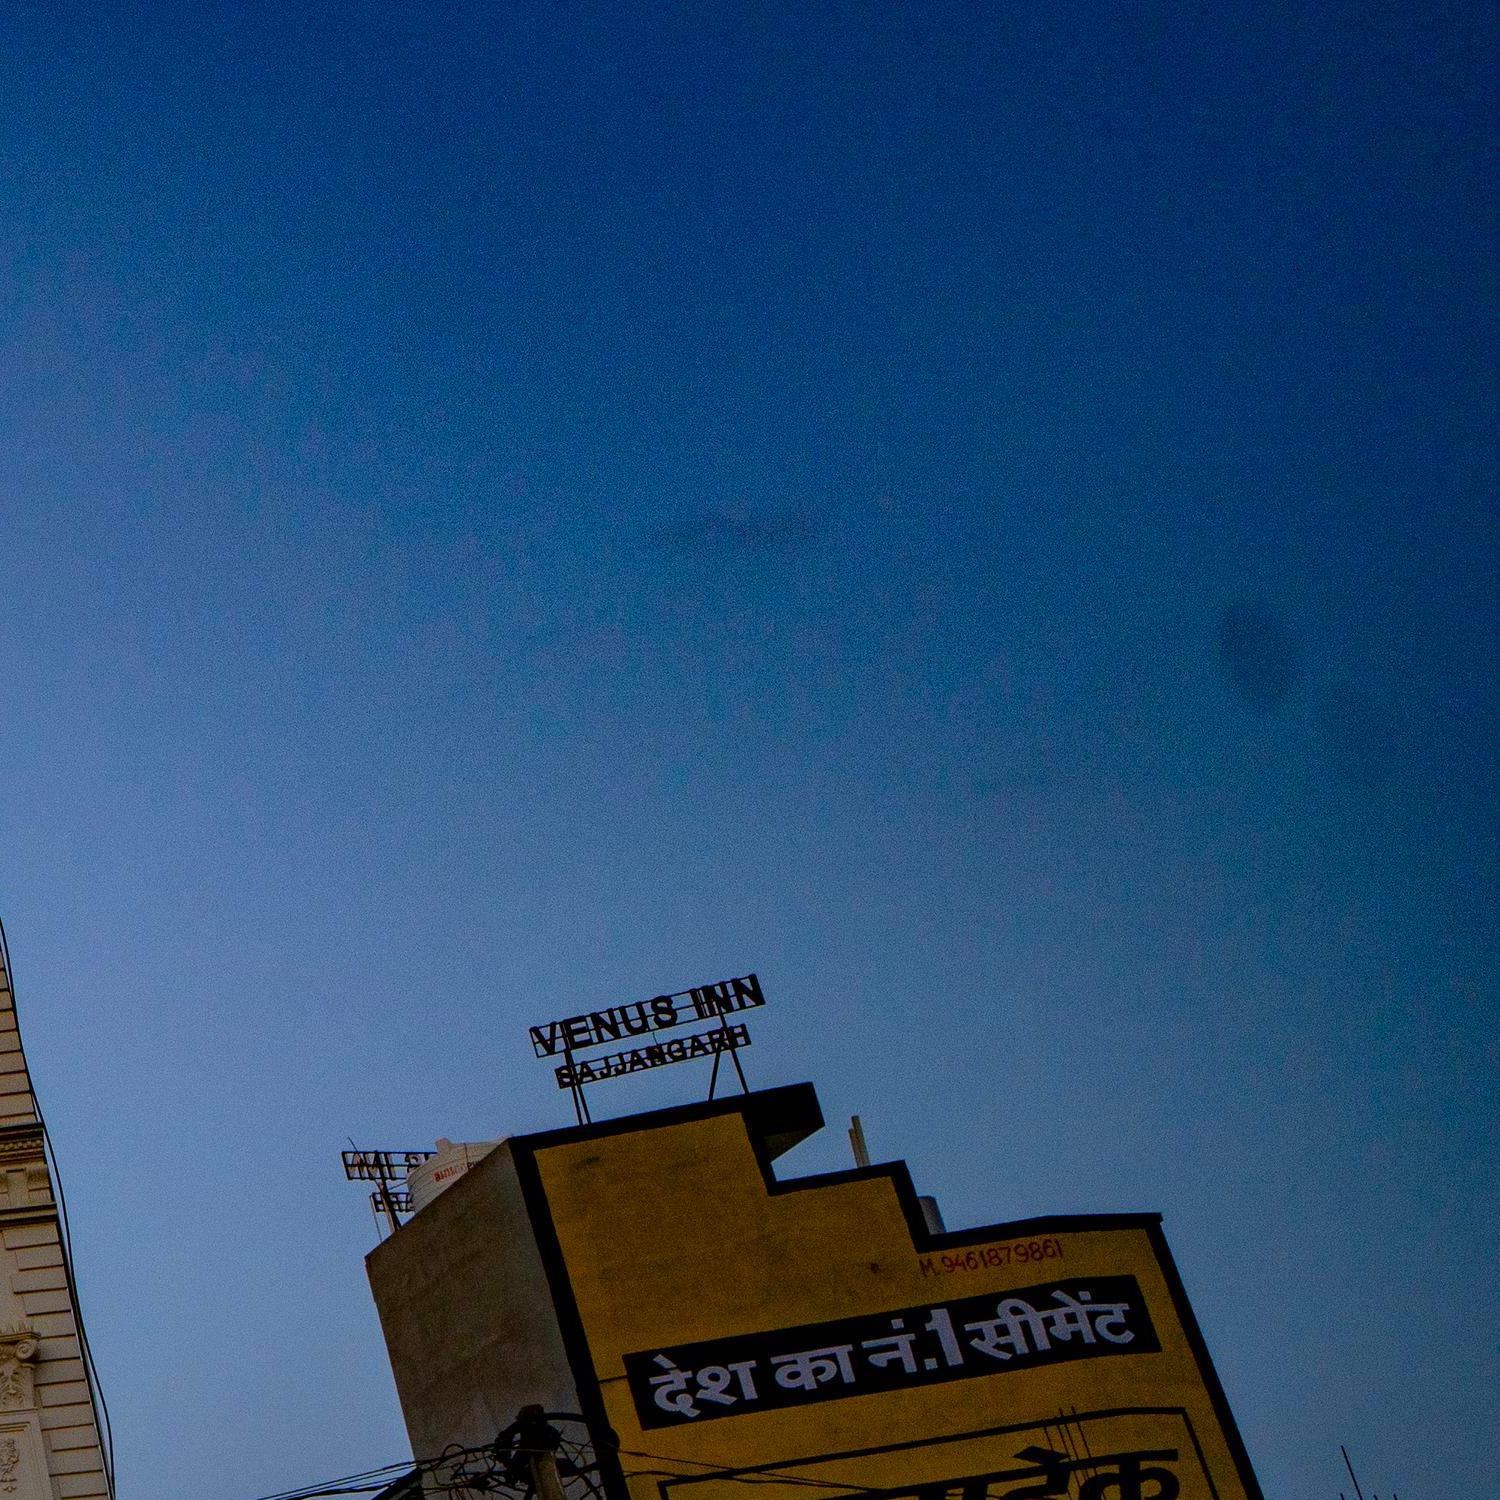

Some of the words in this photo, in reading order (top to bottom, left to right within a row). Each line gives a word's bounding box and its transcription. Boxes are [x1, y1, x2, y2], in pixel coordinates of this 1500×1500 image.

[529, 995, 678, 1057] VENUS
[689, 973, 765, 1020] INN
[555, 1024, 751, 1088] SAJJANGARH
[648, 1354, 758, 1418] देश
[771, 1344, 858, 1393] का
